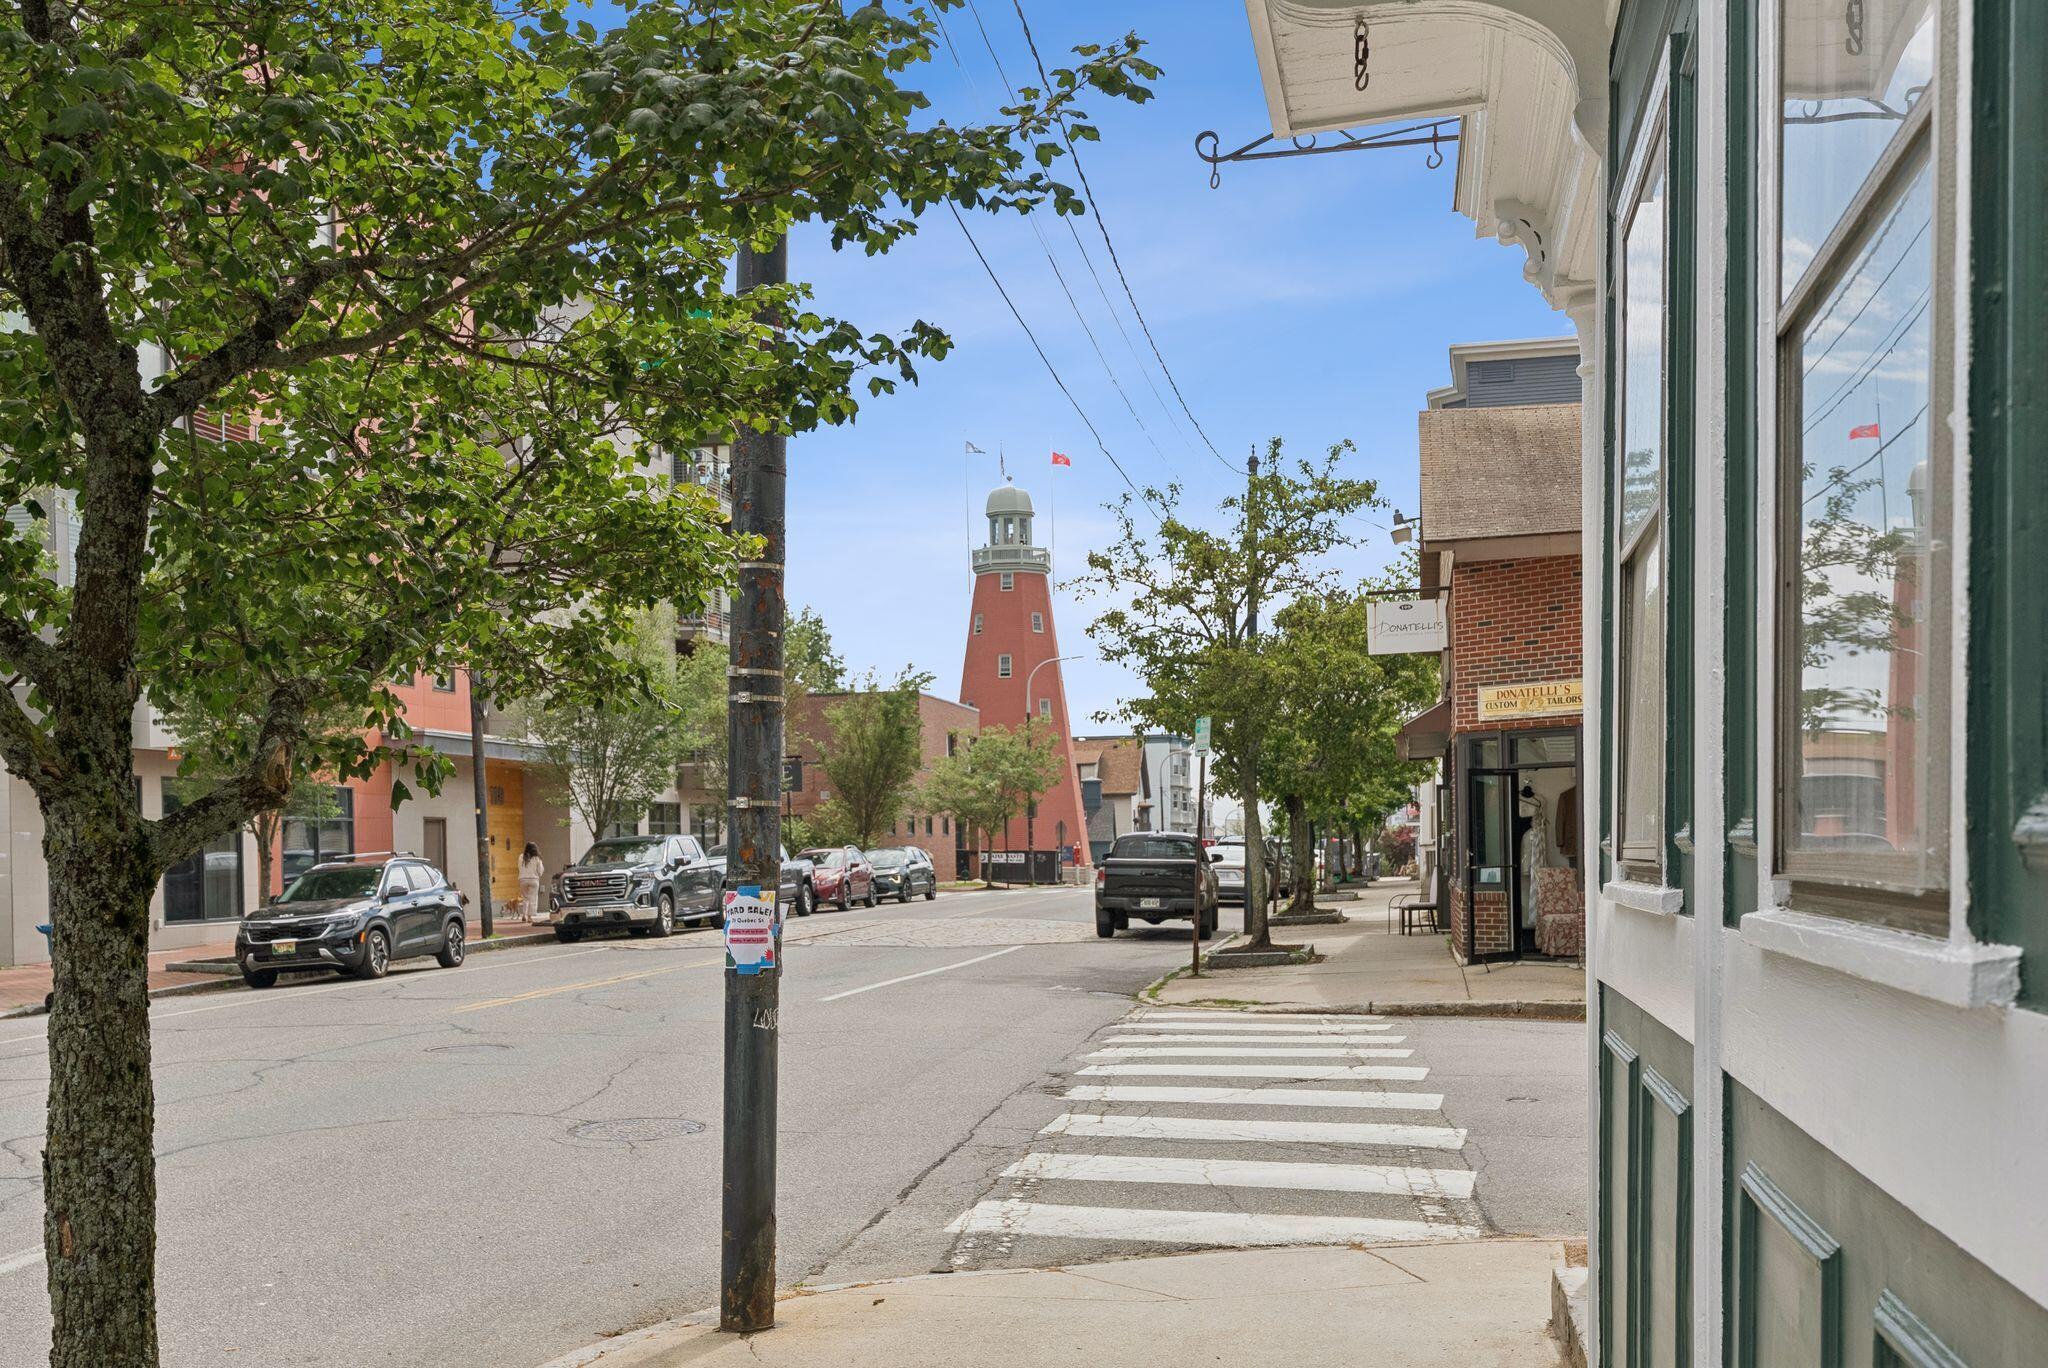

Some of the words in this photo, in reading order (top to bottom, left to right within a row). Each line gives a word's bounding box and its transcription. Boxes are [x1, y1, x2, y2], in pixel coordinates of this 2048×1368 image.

[1371, 619, 1444, 635] DONATELLI'S
[1496, 684, 1571, 700] DONATELLI'S
[1485, 700, 1518, 710] CUSTOM
[1547, 695, 1582, 705] TAILORS
